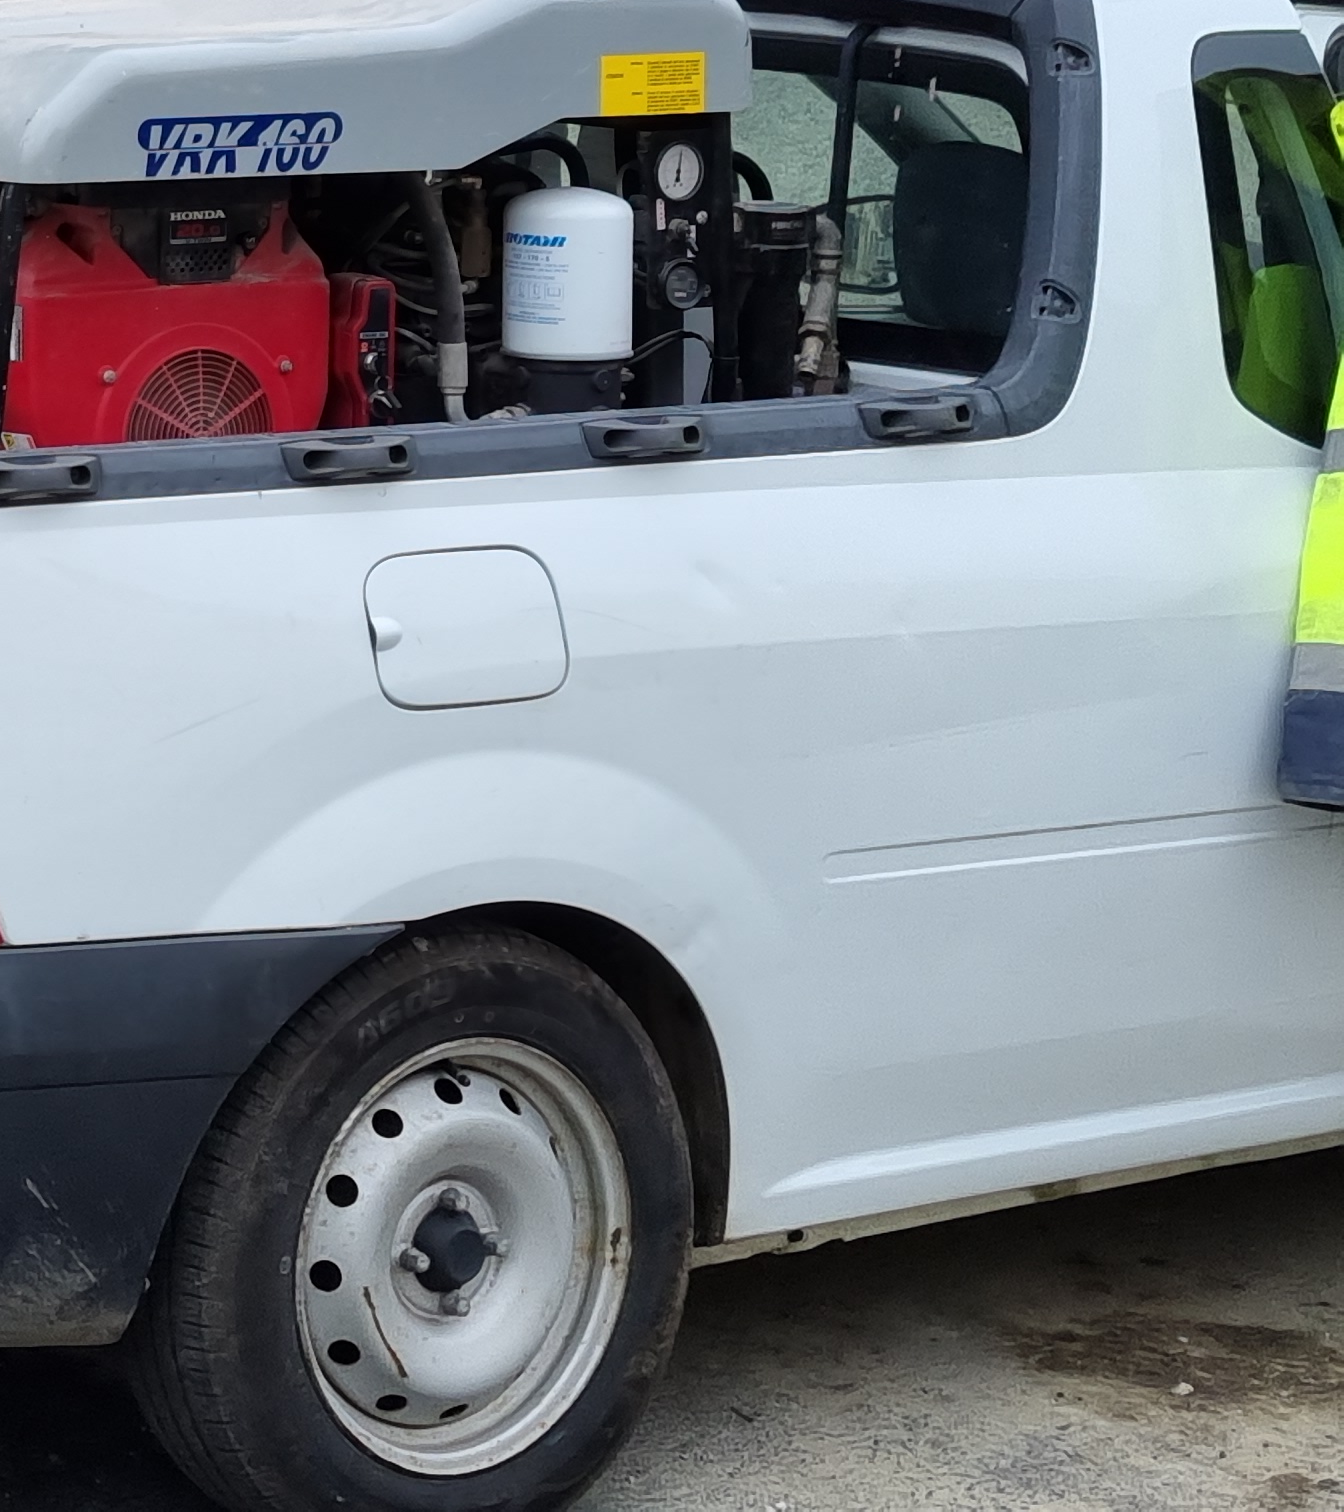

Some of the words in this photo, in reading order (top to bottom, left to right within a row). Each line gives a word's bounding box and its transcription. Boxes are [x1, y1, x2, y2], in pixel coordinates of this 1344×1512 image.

[146, 120, 255, 177] VRK
[257, 117, 336, 173] 160
[170, 209, 226, 221] HONDA
